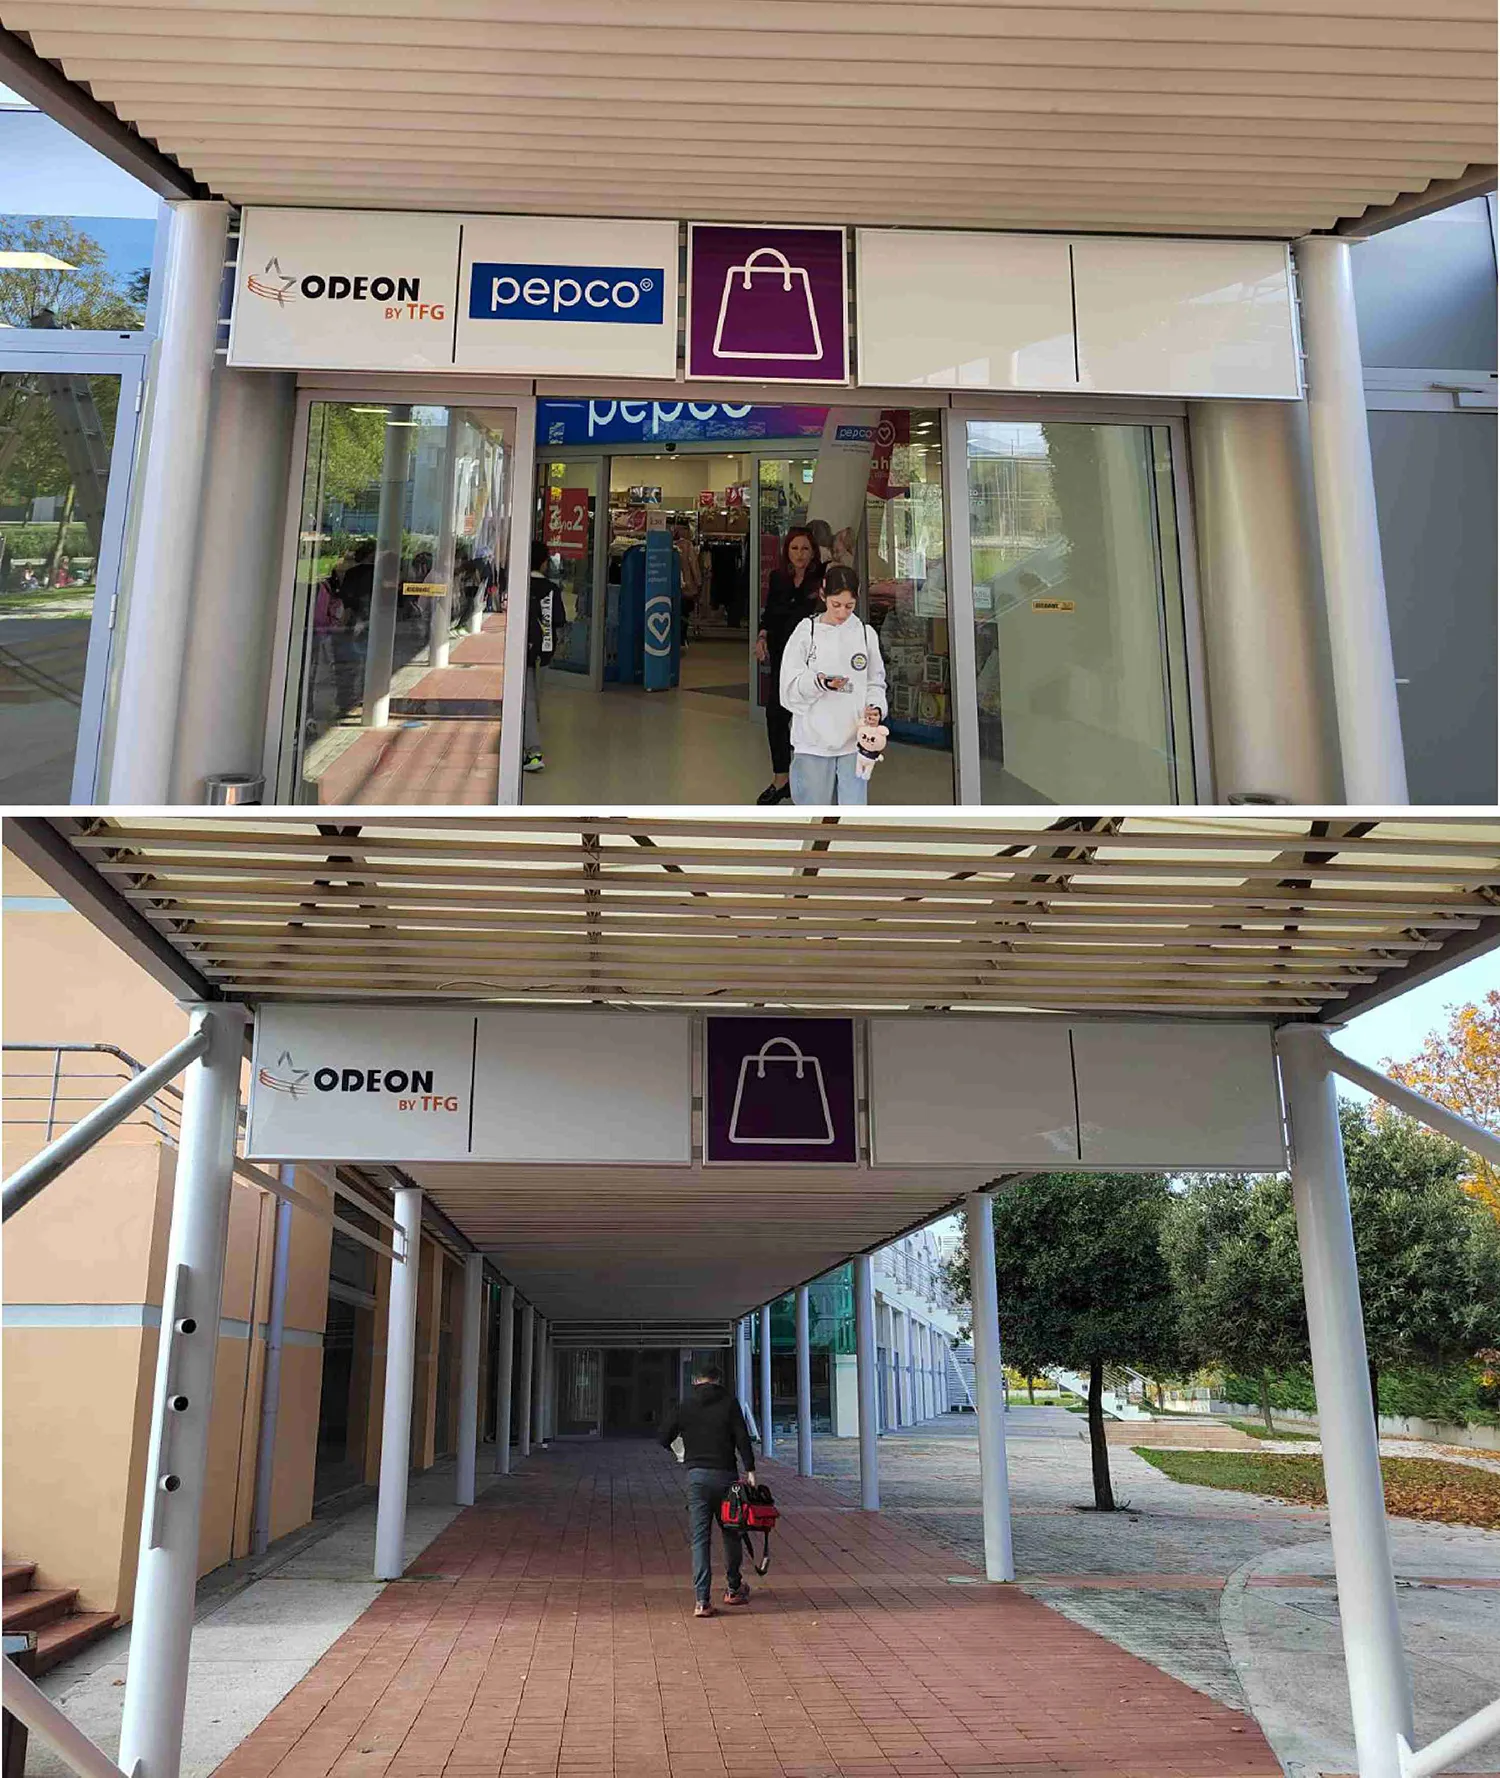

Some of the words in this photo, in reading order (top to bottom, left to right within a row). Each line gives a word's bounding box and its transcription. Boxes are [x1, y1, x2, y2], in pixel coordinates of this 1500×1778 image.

[300, 275, 420, 302] ODEON
[490, 274, 641, 313] pepco
[384, 307, 403, 320] BY
[407, 303, 446, 321] TFG
[839, 428, 873, 439] pepco
[313, 1067, 434, 1094] ODEON
[398, 1099, 416, 1111] BY
[420, 1095, 459, 1111] TFG
